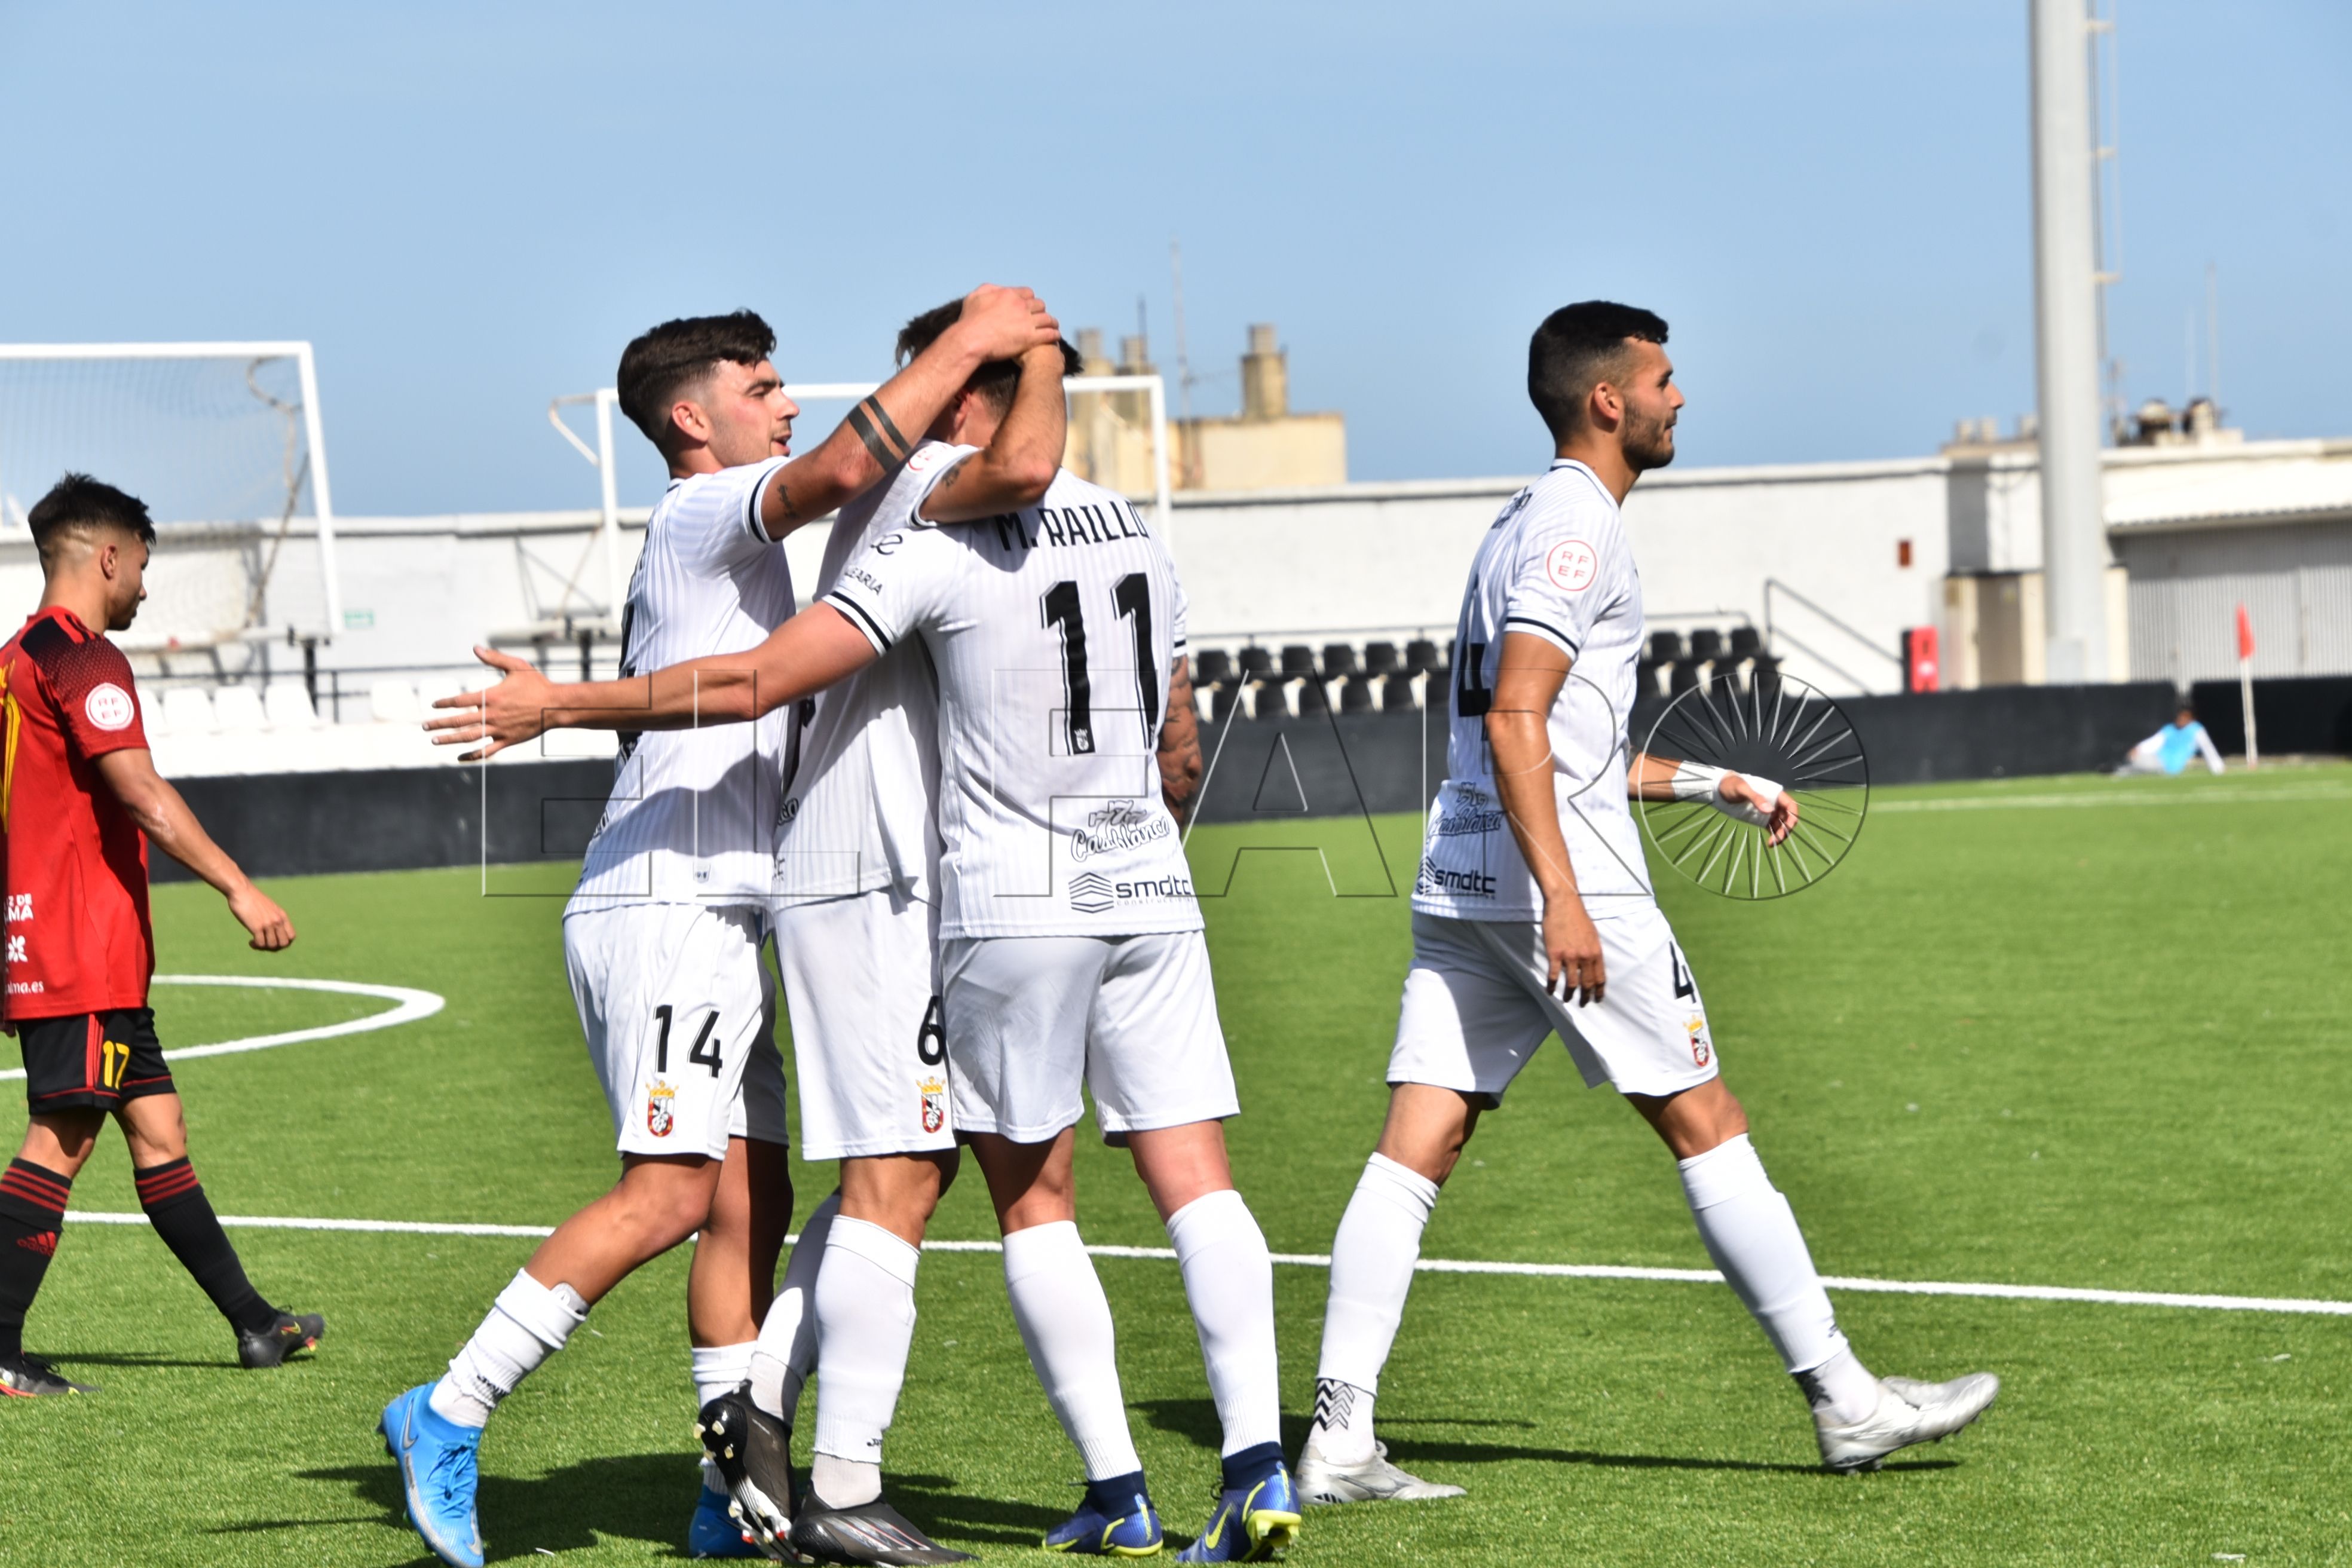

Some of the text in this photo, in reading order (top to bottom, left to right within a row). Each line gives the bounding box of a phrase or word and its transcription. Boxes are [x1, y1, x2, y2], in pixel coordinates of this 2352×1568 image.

[1037, 501, 1150, 547] RAILLO
[1040, 572, 1159, 757] 11
[1434, 869, 1496, 894] smdtc
[1670, 941, 1696, 1004] 4
[653, 1004, 722, 1079] 14
[917, 994, 945, 1065] 6
[103, 1040, 130, 1090] 17
